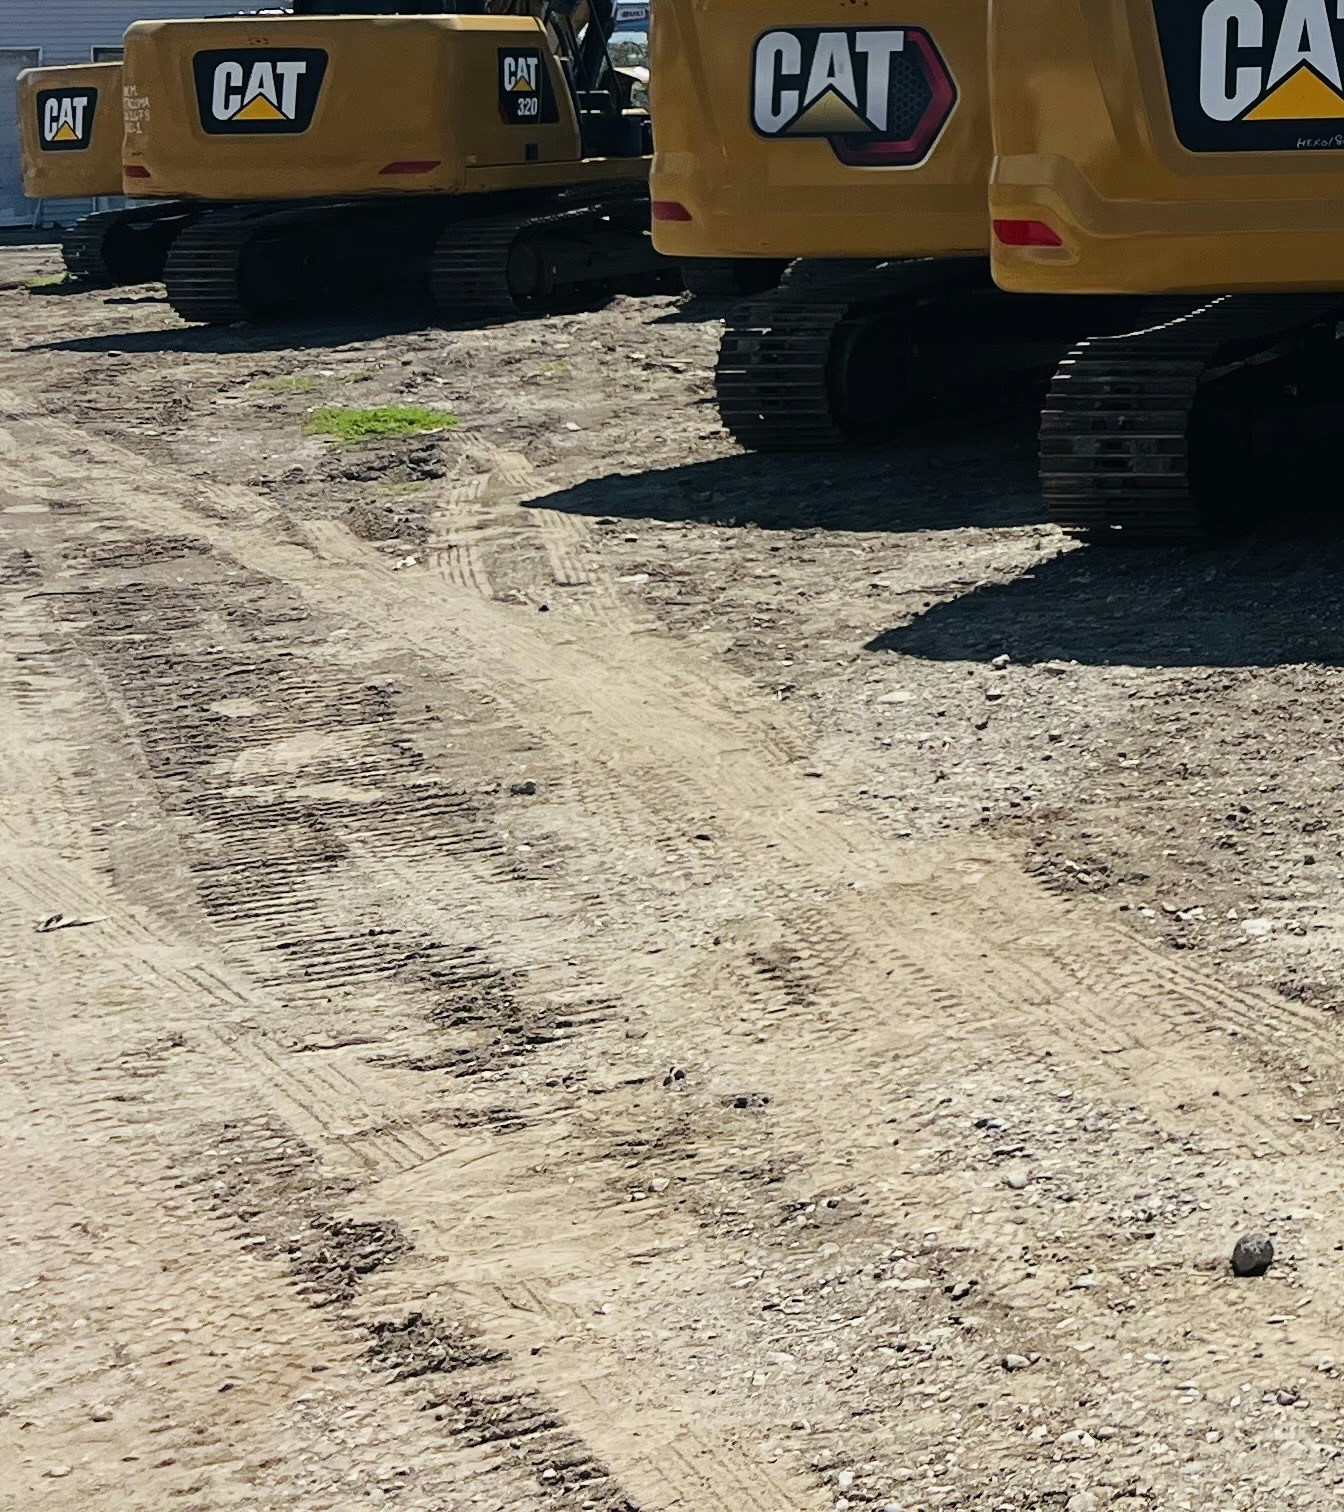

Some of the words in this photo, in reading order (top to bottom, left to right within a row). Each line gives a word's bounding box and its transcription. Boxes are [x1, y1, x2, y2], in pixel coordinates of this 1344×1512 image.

[212, 61, 307, 121] CAT
[504, 57, 538, 91] CAT
[754, 30, 905, 134] CAT
[44, 96, 88, 141] CAT
[517, 97, 538, 116] 320
